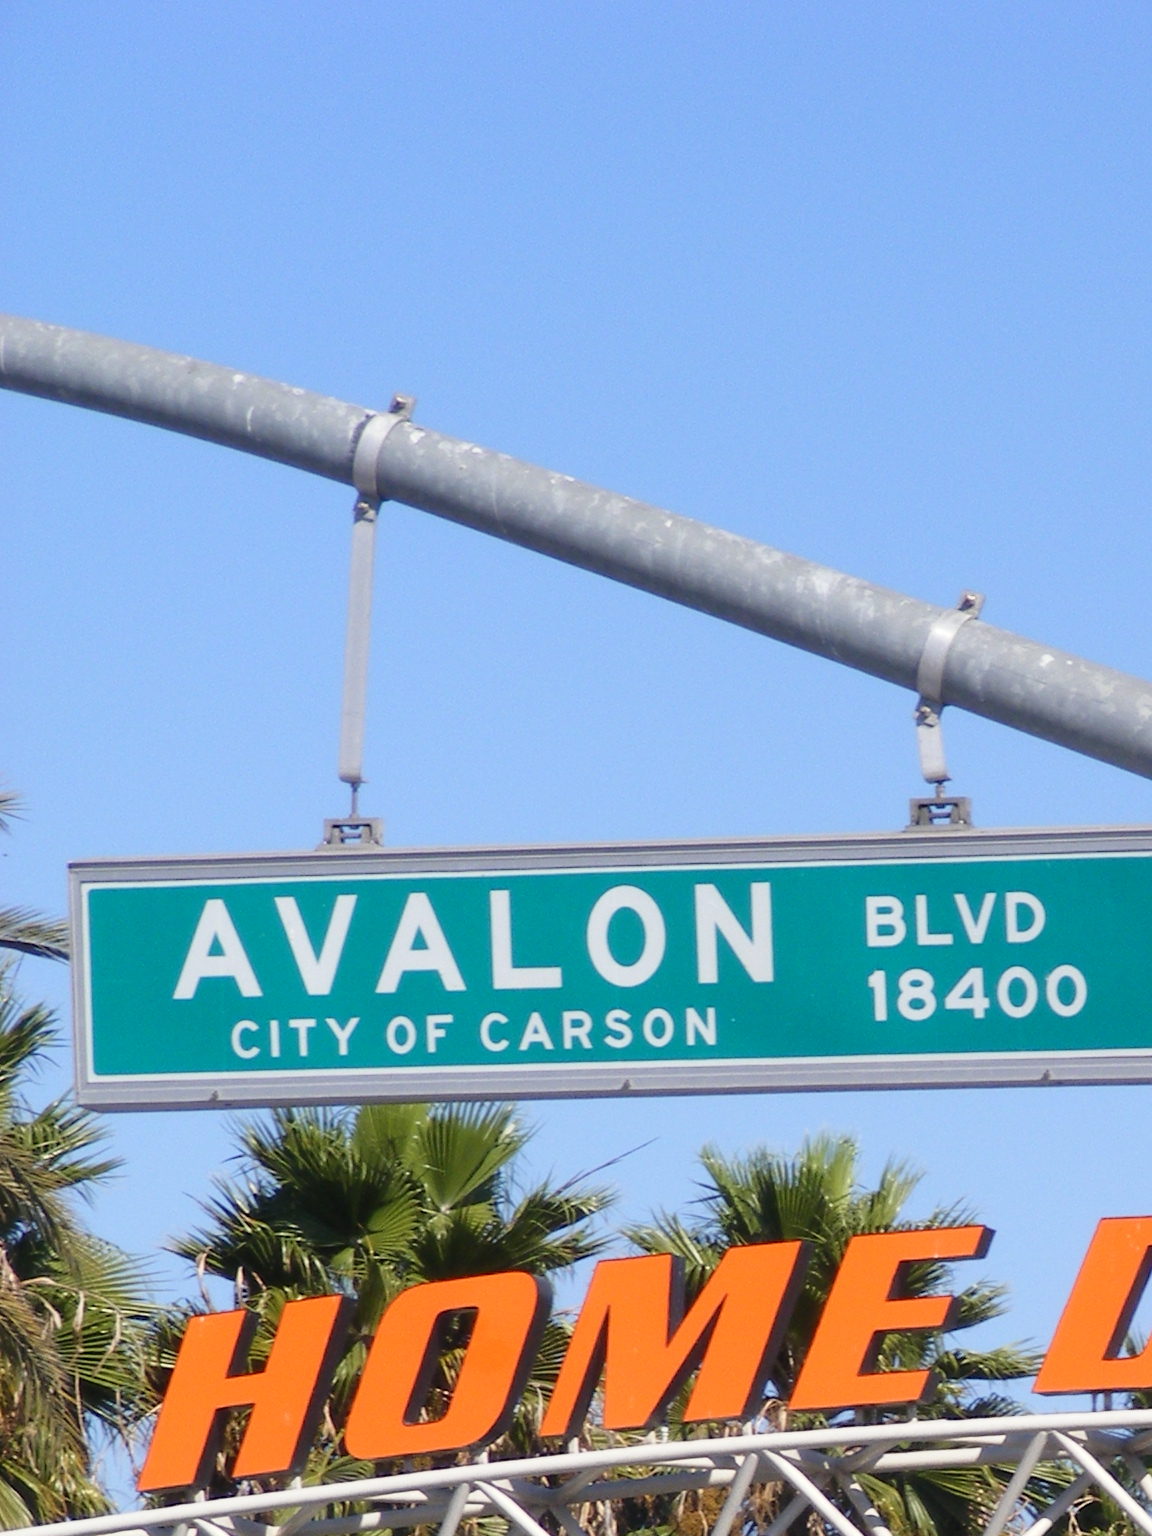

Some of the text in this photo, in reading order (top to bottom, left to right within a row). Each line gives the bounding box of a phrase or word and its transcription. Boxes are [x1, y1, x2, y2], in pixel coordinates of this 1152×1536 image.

[173, 882, 774, 1000] AVALON
[865, 891, 1047, 948] BLVD
[867, 964, 1088, 1022] 18400
[231, 1007, 718, 1060] CITY OF CARSON
[136, 1225, 990, 1493] HOME
